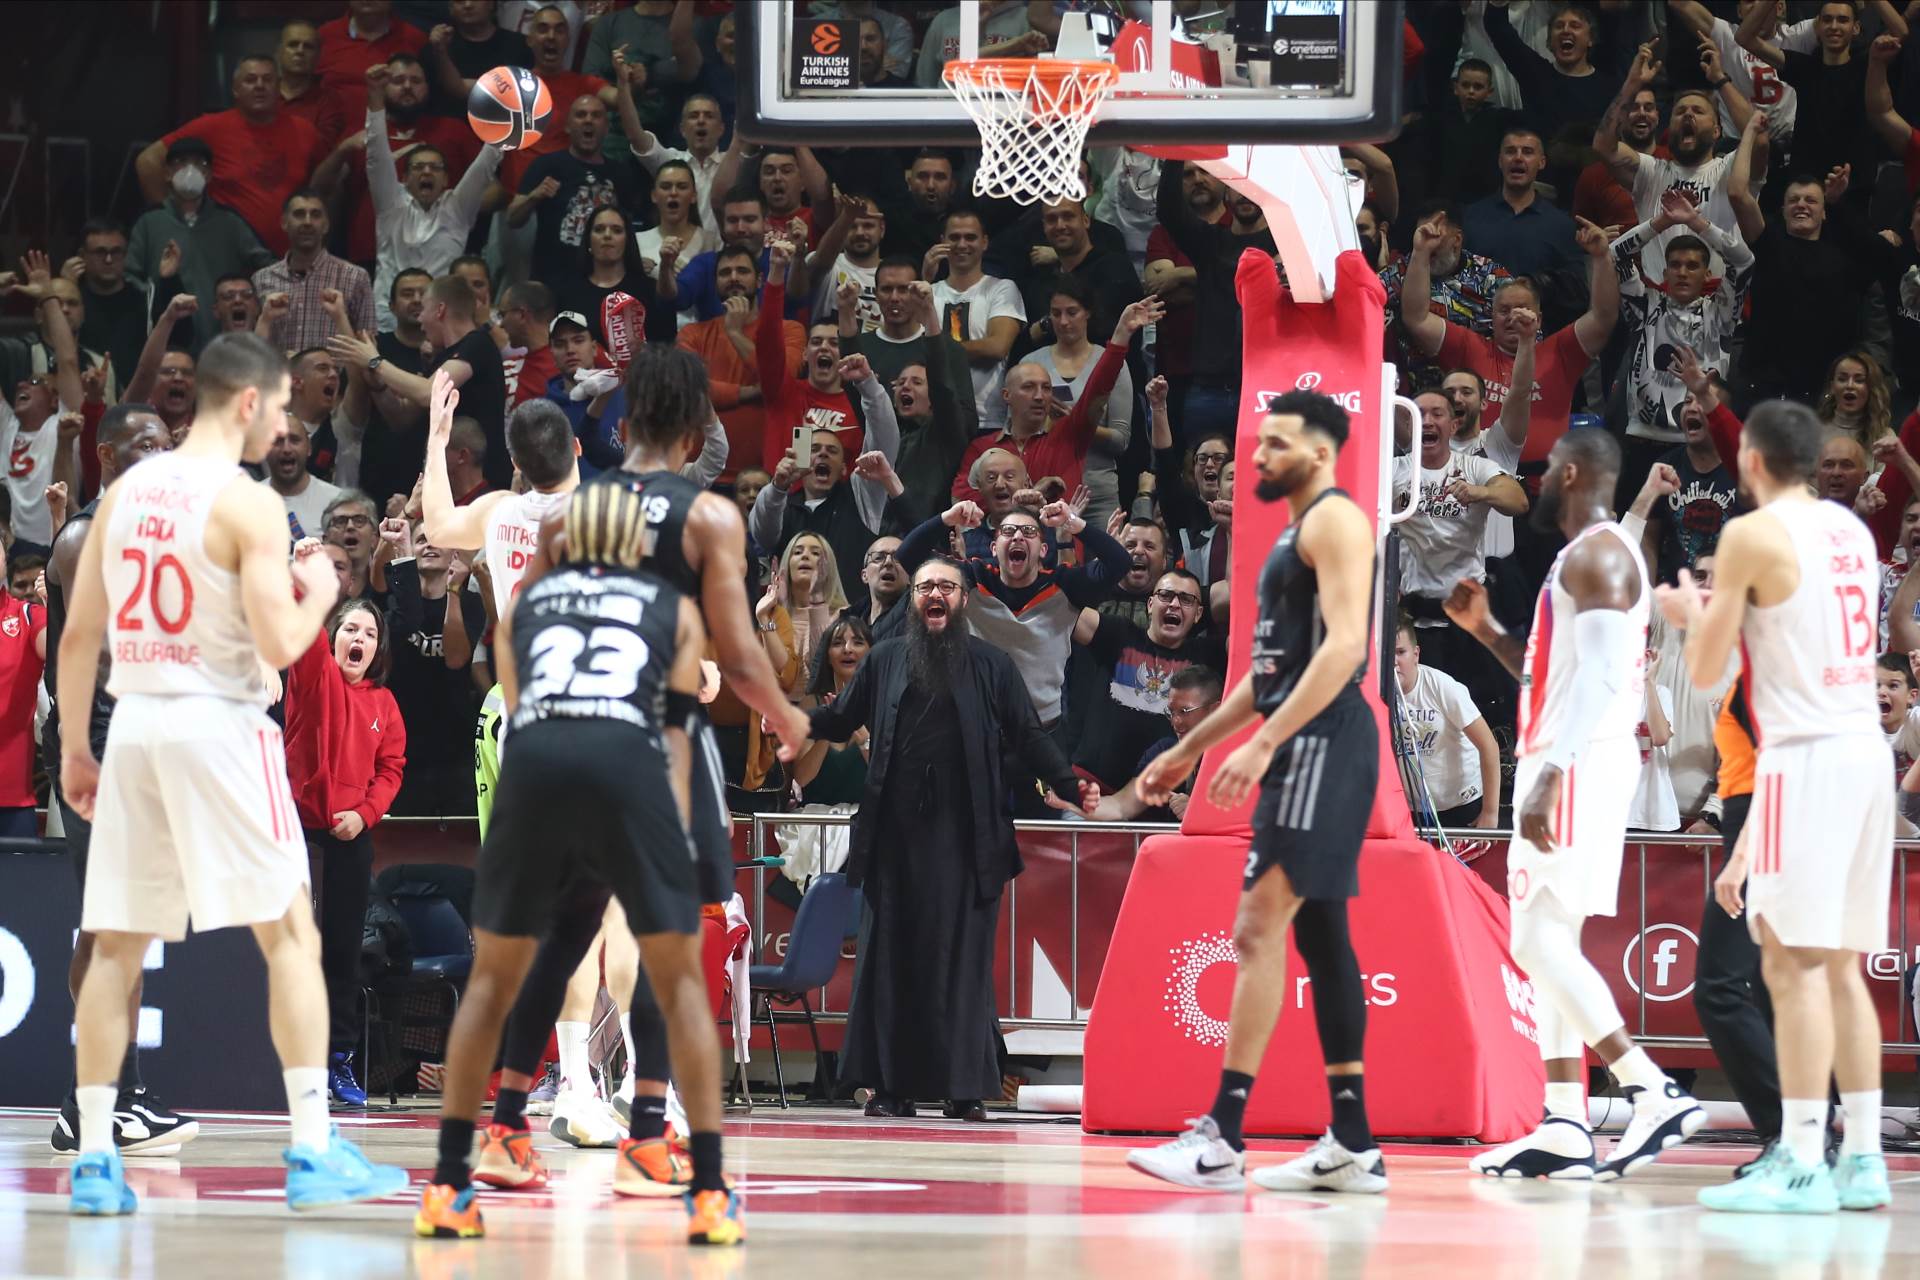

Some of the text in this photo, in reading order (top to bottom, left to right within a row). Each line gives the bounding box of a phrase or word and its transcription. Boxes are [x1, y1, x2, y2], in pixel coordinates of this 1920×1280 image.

[1290, 45, 1337, 54] oneteam
[801, 67, 849, 76] AIRLINES
[802, 56, 849, 66] TURKISH
[800, 77, 849, 87] EuroLeague
[806, 407, 847, 428] NIKE
[1668, 481, 1736, 511] Chilled out
[117, 549, 194, 634] 20
[1834, 585, 1873, 658] 13
[117, 642, 201, 667] BELGRADE
